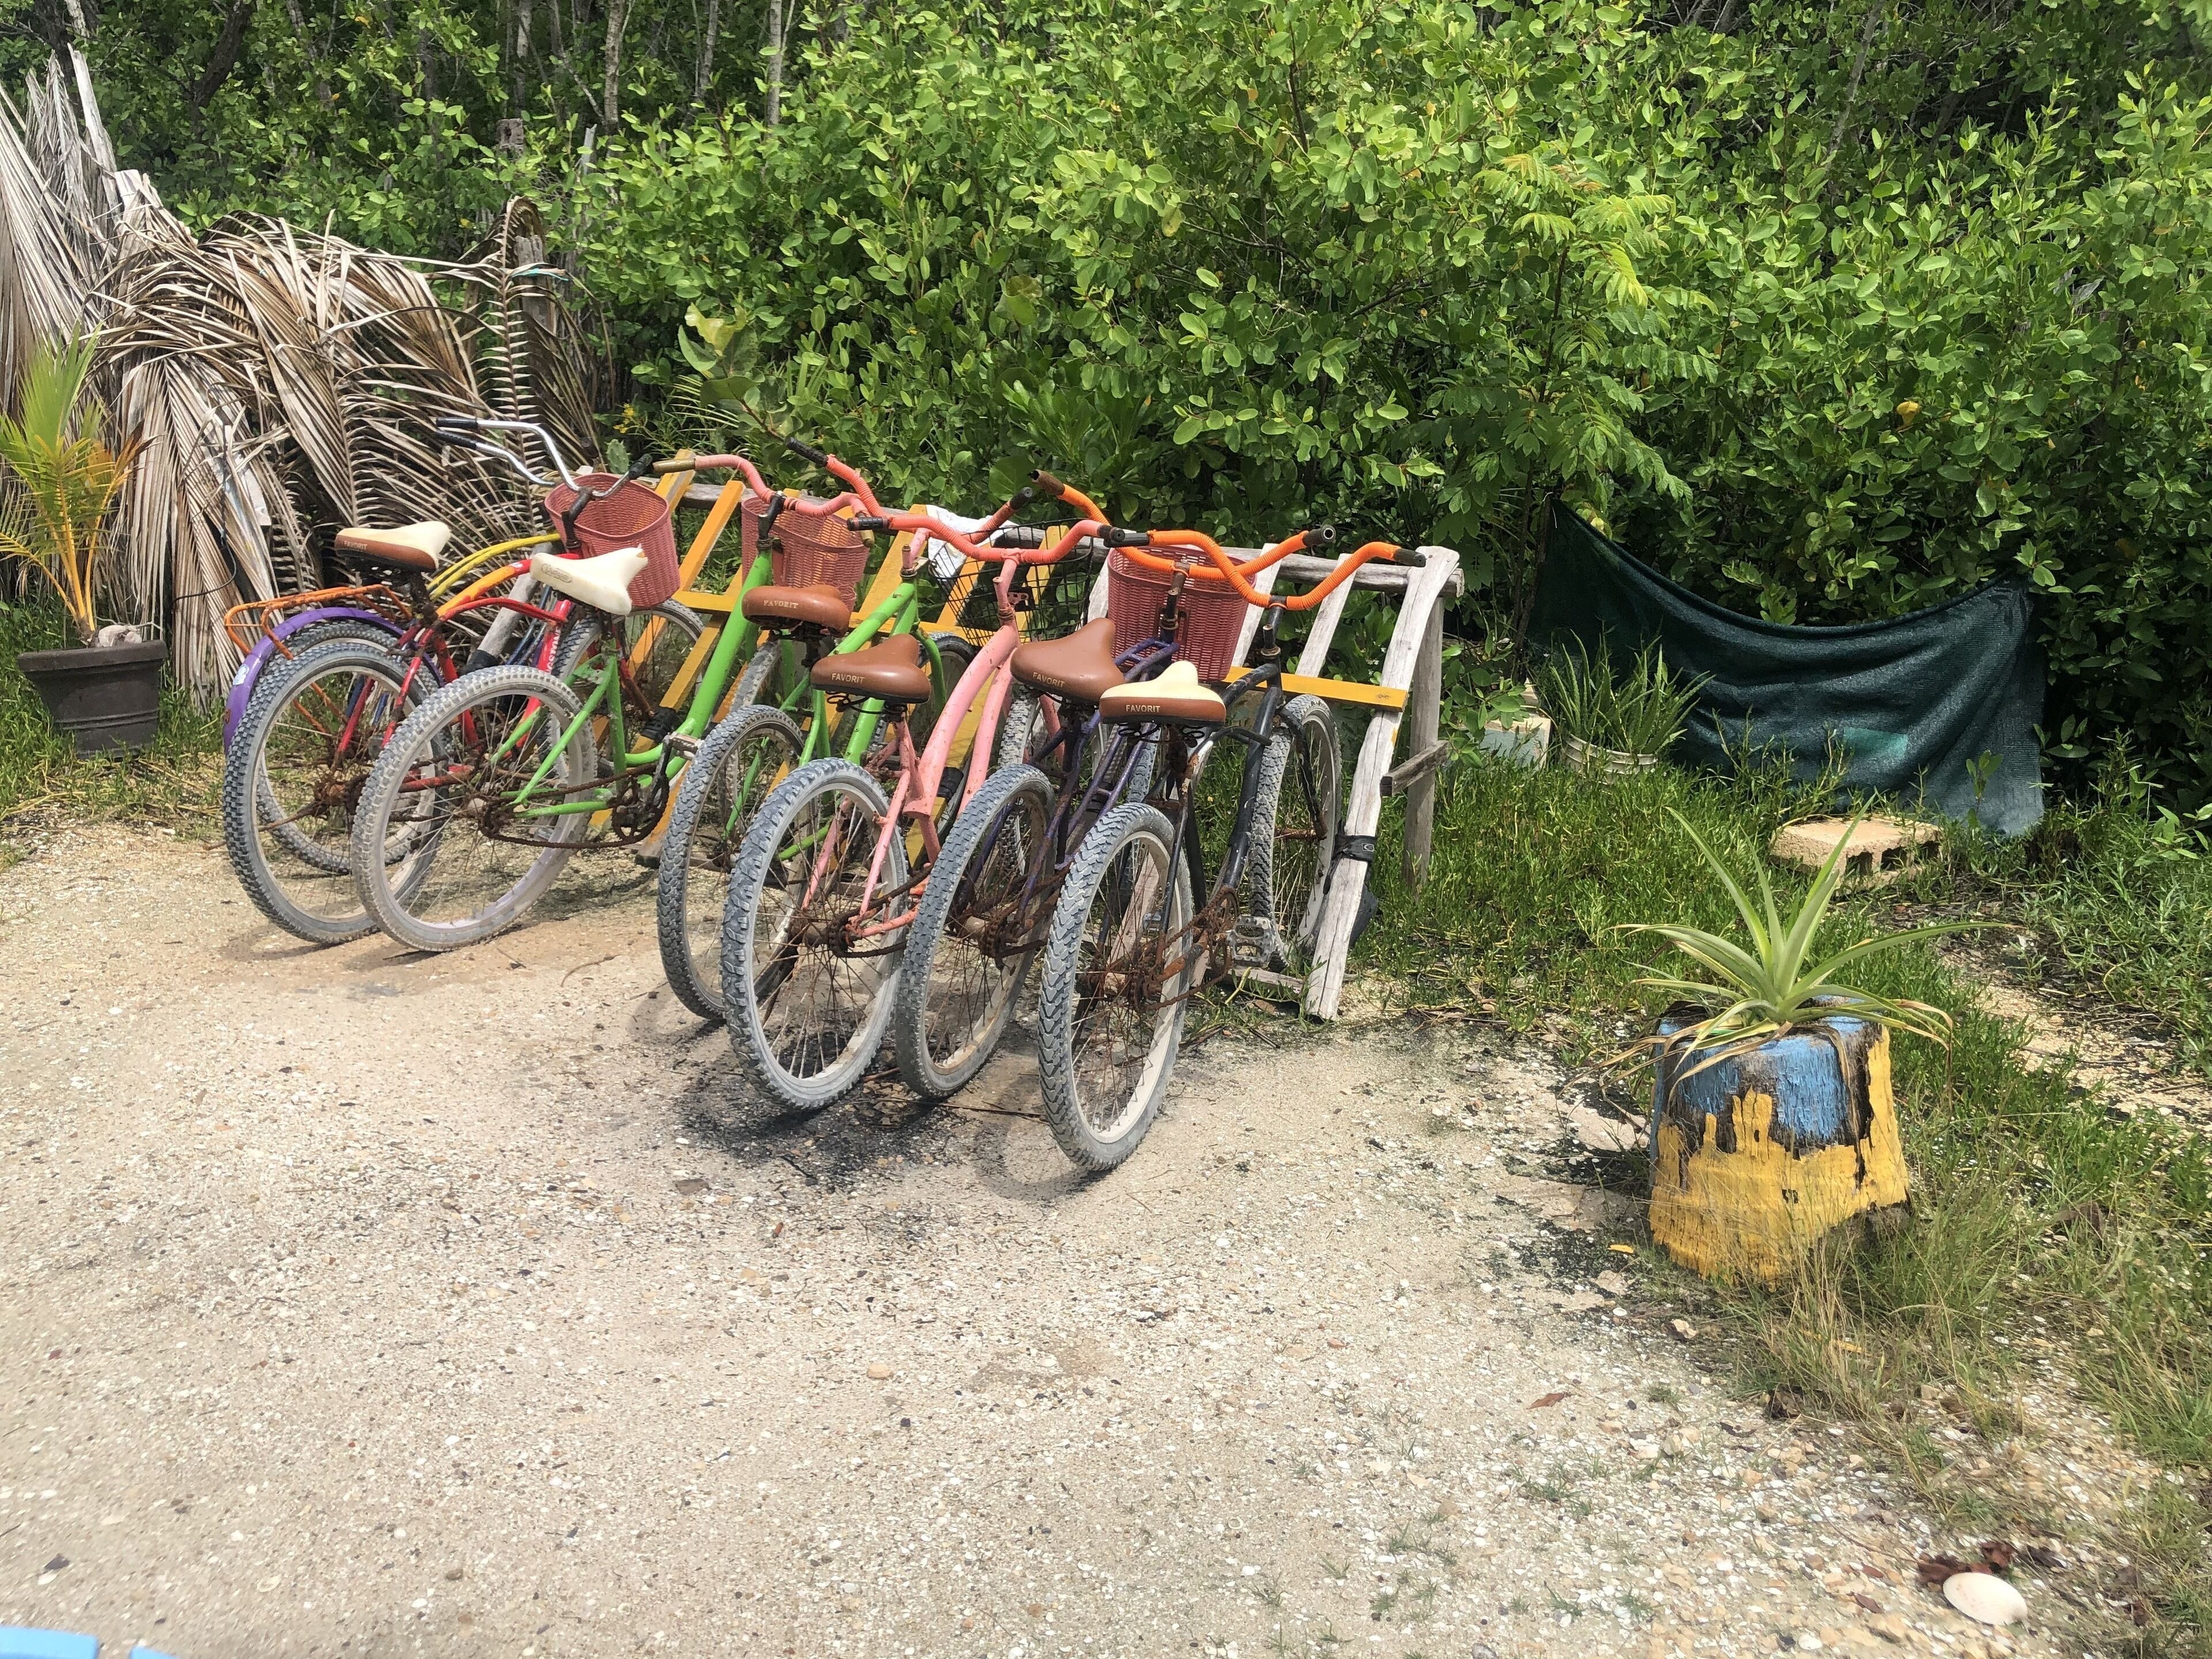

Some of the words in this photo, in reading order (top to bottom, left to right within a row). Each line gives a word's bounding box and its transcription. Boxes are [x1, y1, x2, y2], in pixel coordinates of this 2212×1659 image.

[763, 600, 799, 609] FAVORIT
[831, 673, 865, 684] FAVORIT
[1032, 672, 1065, 687] FAVORIT
[1126, 704, 1161, 713] FAVORIT
